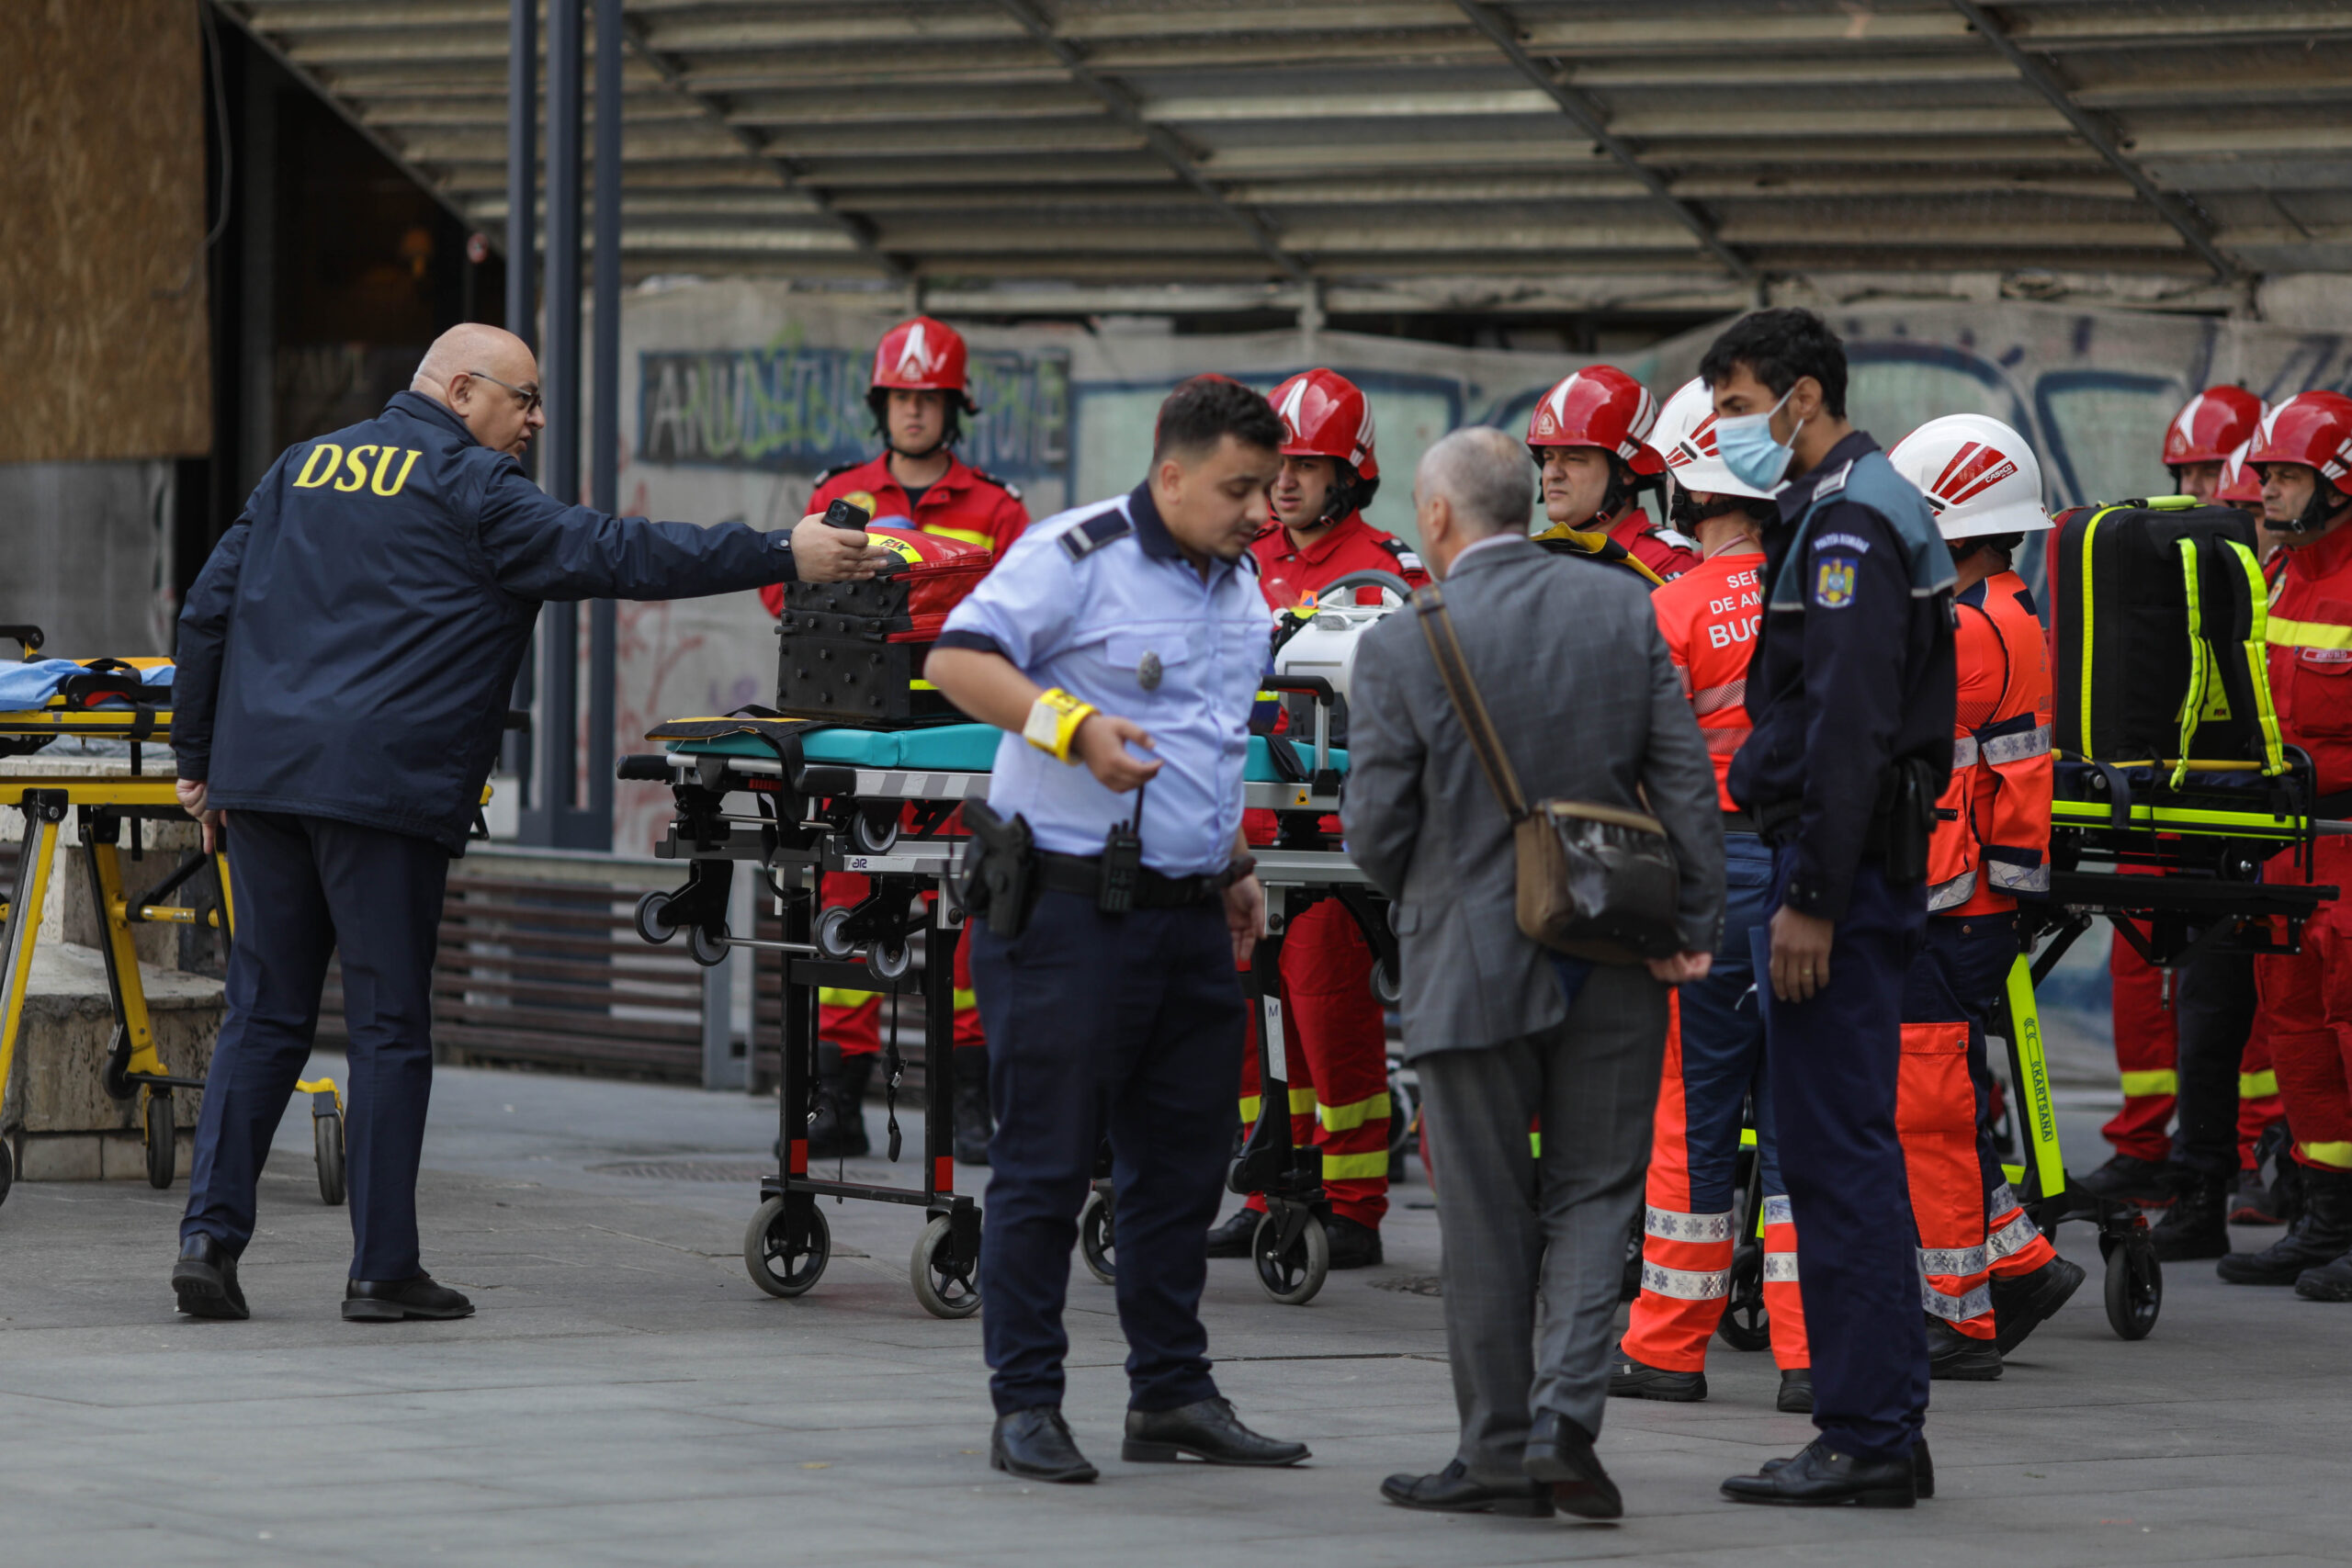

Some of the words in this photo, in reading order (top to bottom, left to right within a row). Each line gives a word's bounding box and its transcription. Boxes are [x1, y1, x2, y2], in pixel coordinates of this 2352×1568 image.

[292, 444, 423, 497] DSU
[1710, 596, 1736, 615] DE
[2033, 1068, 2052, 1140] KARTSANA
